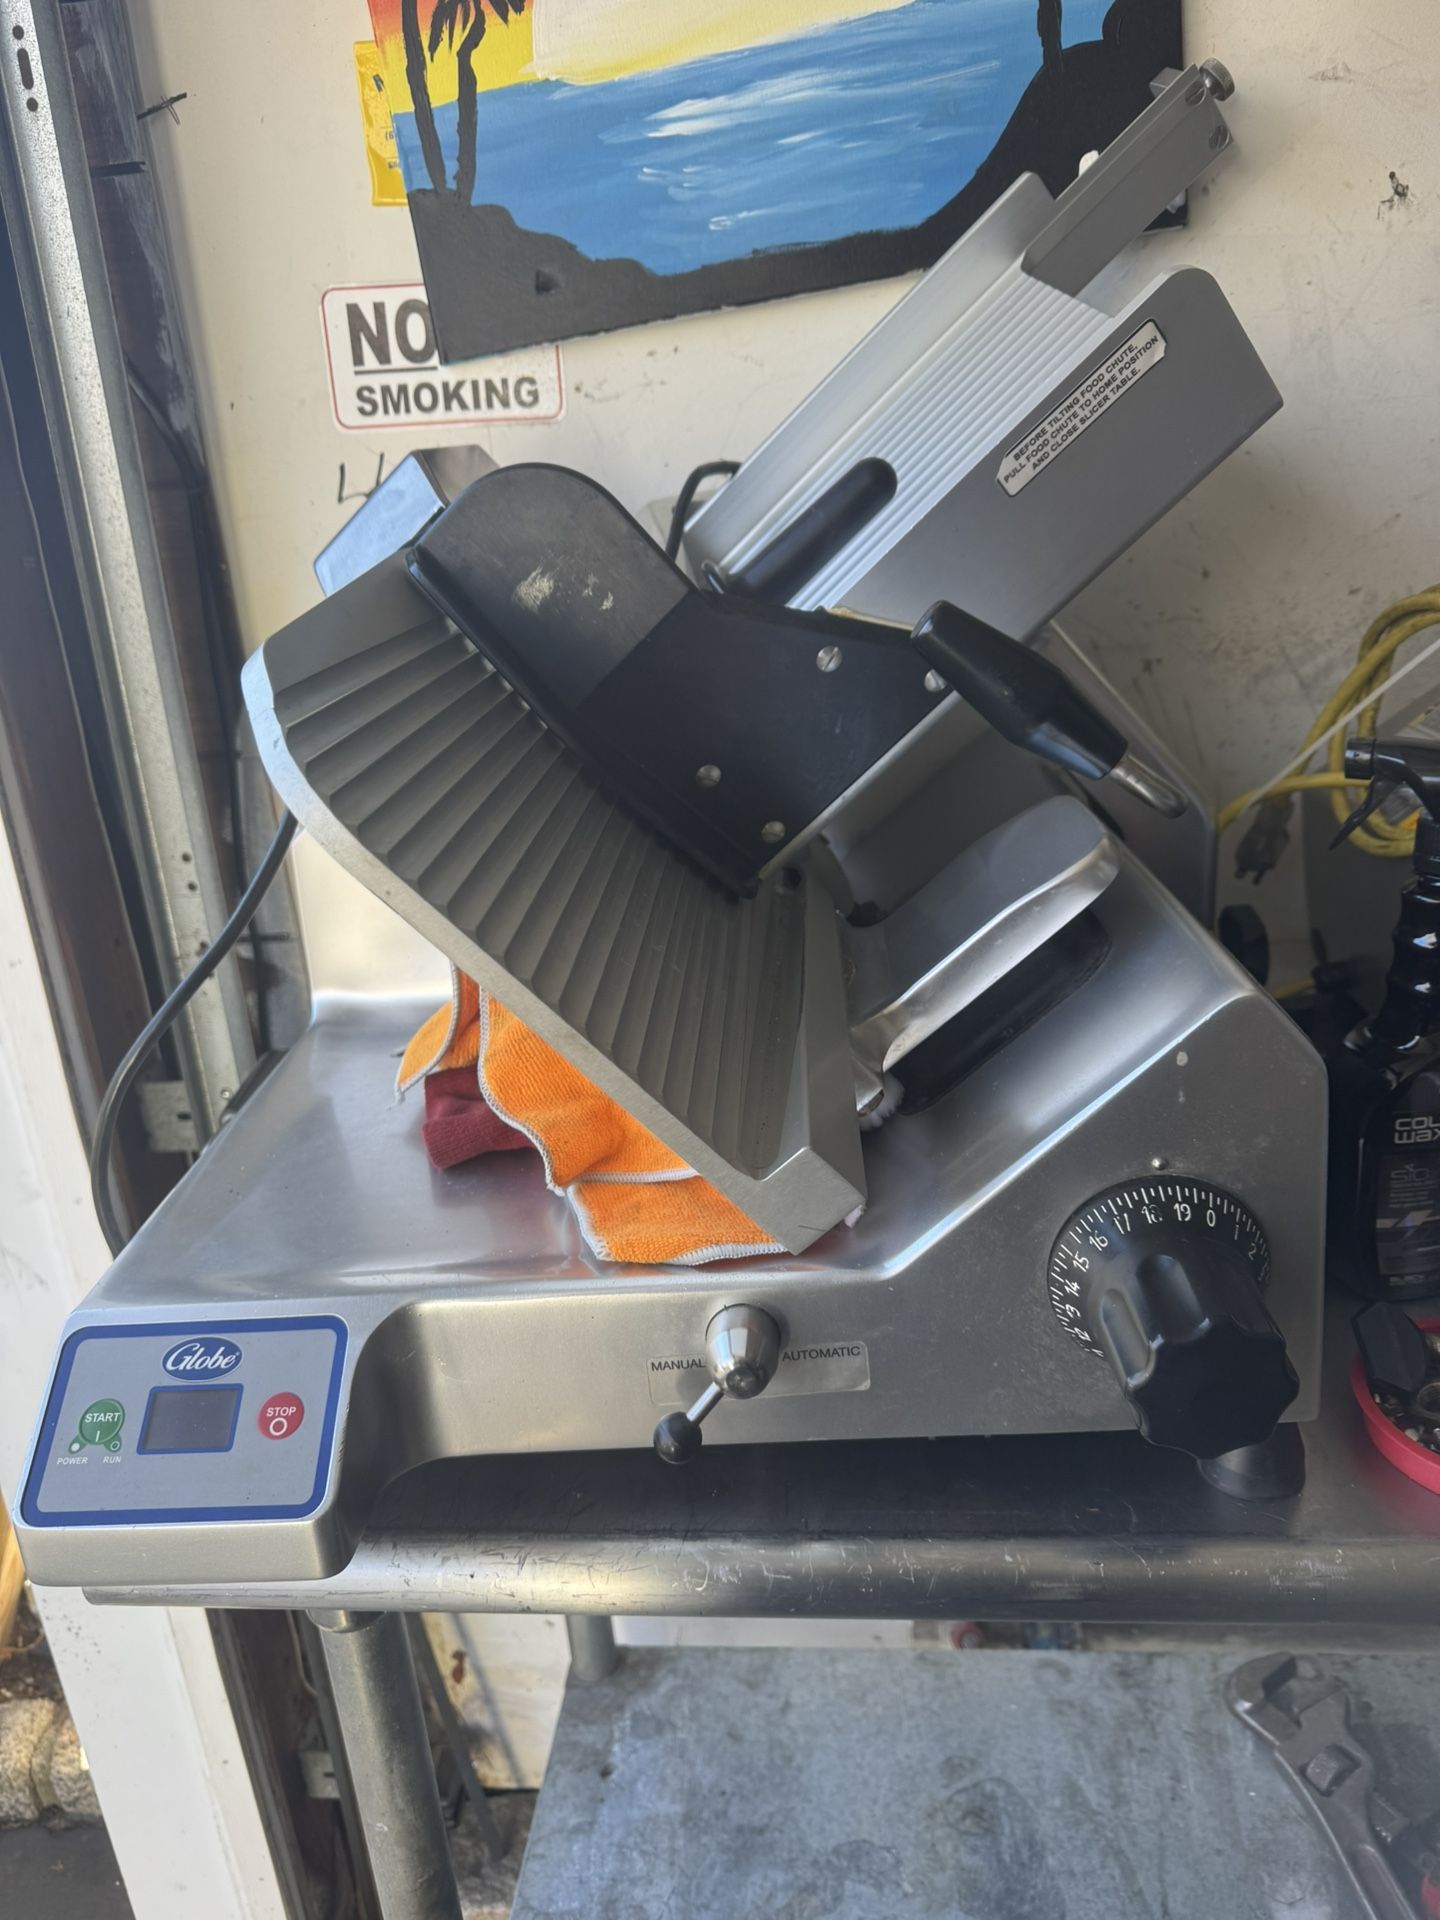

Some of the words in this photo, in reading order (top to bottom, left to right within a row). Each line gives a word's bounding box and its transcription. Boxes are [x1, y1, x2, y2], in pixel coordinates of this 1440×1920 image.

[345, 298, 437, 367] NO
[356, 376, 540, 417] SMOKING
[1003, 463, 1026, 484] PULL
[1026, 438, 1050, 463] FOOD
[1050, 412, 1079, 439] CHUTE
[1079, 399, 1092, 413] TO
[1092, 374, 1118, 400] HOME
[1118, 335, 1159, 375] POSITION
[1013, 427, 1048, 462] BEFORE
[1048, 397, 1080, 429] TILTING
[1080, 373, 1105, 398] FOOD
[1105, 343, 1139, 374] CHUTE,
[1032, 451, 1050, 471] AND
[1050, 425, 1079, 452] CLOSE
[1079, 395, 1111, 425] SLICER
[1110, 367, 1141, 396] TABLE.
[1064, 1279, 1080, 1297] 14
[1072, 1251, 1089, 1272] 15
[1089, 1230, 1109, 1251] 16
[1113, 1212, 1131, 1235] 17
[1173, 1203, 1192, 1221] 19
[1206, 1209, 1216, 1227] 0
[1248, 1242, 1257, 1261] 2
[166, 1342, 236, 1370] Globe
[651, 1358, 706, 1372] MANUAL
[782, 1345, 861, 1362] AUTOMATIC
[84, 1412, 121, 1423] START
[266, 1406, 297, 1418] STOP
[56, 1456, 88, 1465] POWER
[103, 1455, 122, 1464] RUN
